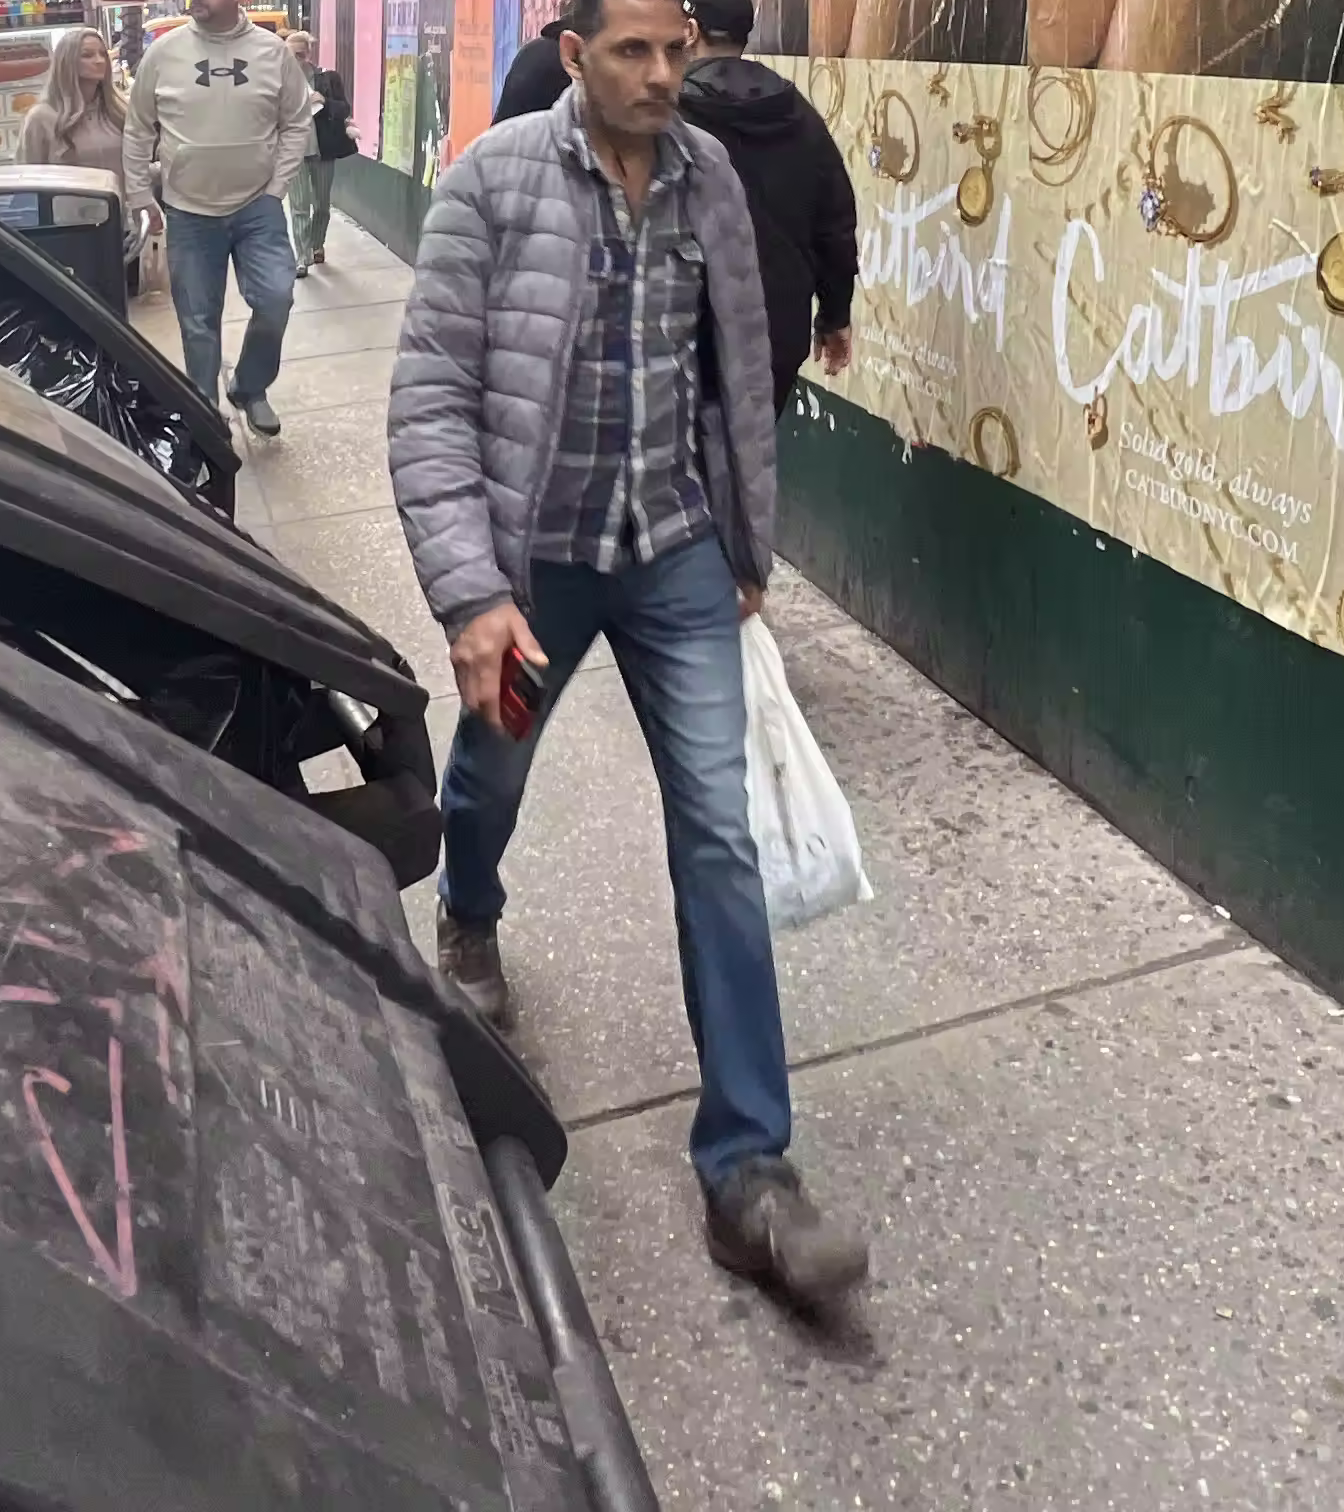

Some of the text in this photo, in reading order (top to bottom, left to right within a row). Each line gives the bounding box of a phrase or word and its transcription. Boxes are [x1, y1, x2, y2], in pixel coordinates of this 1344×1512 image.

[858, 181, 1012, 352] atbird
[1119, 421, 1312, 528] Solid gold, always
[1125, 468, 1301, 565] CATBIRDNYC.COM
